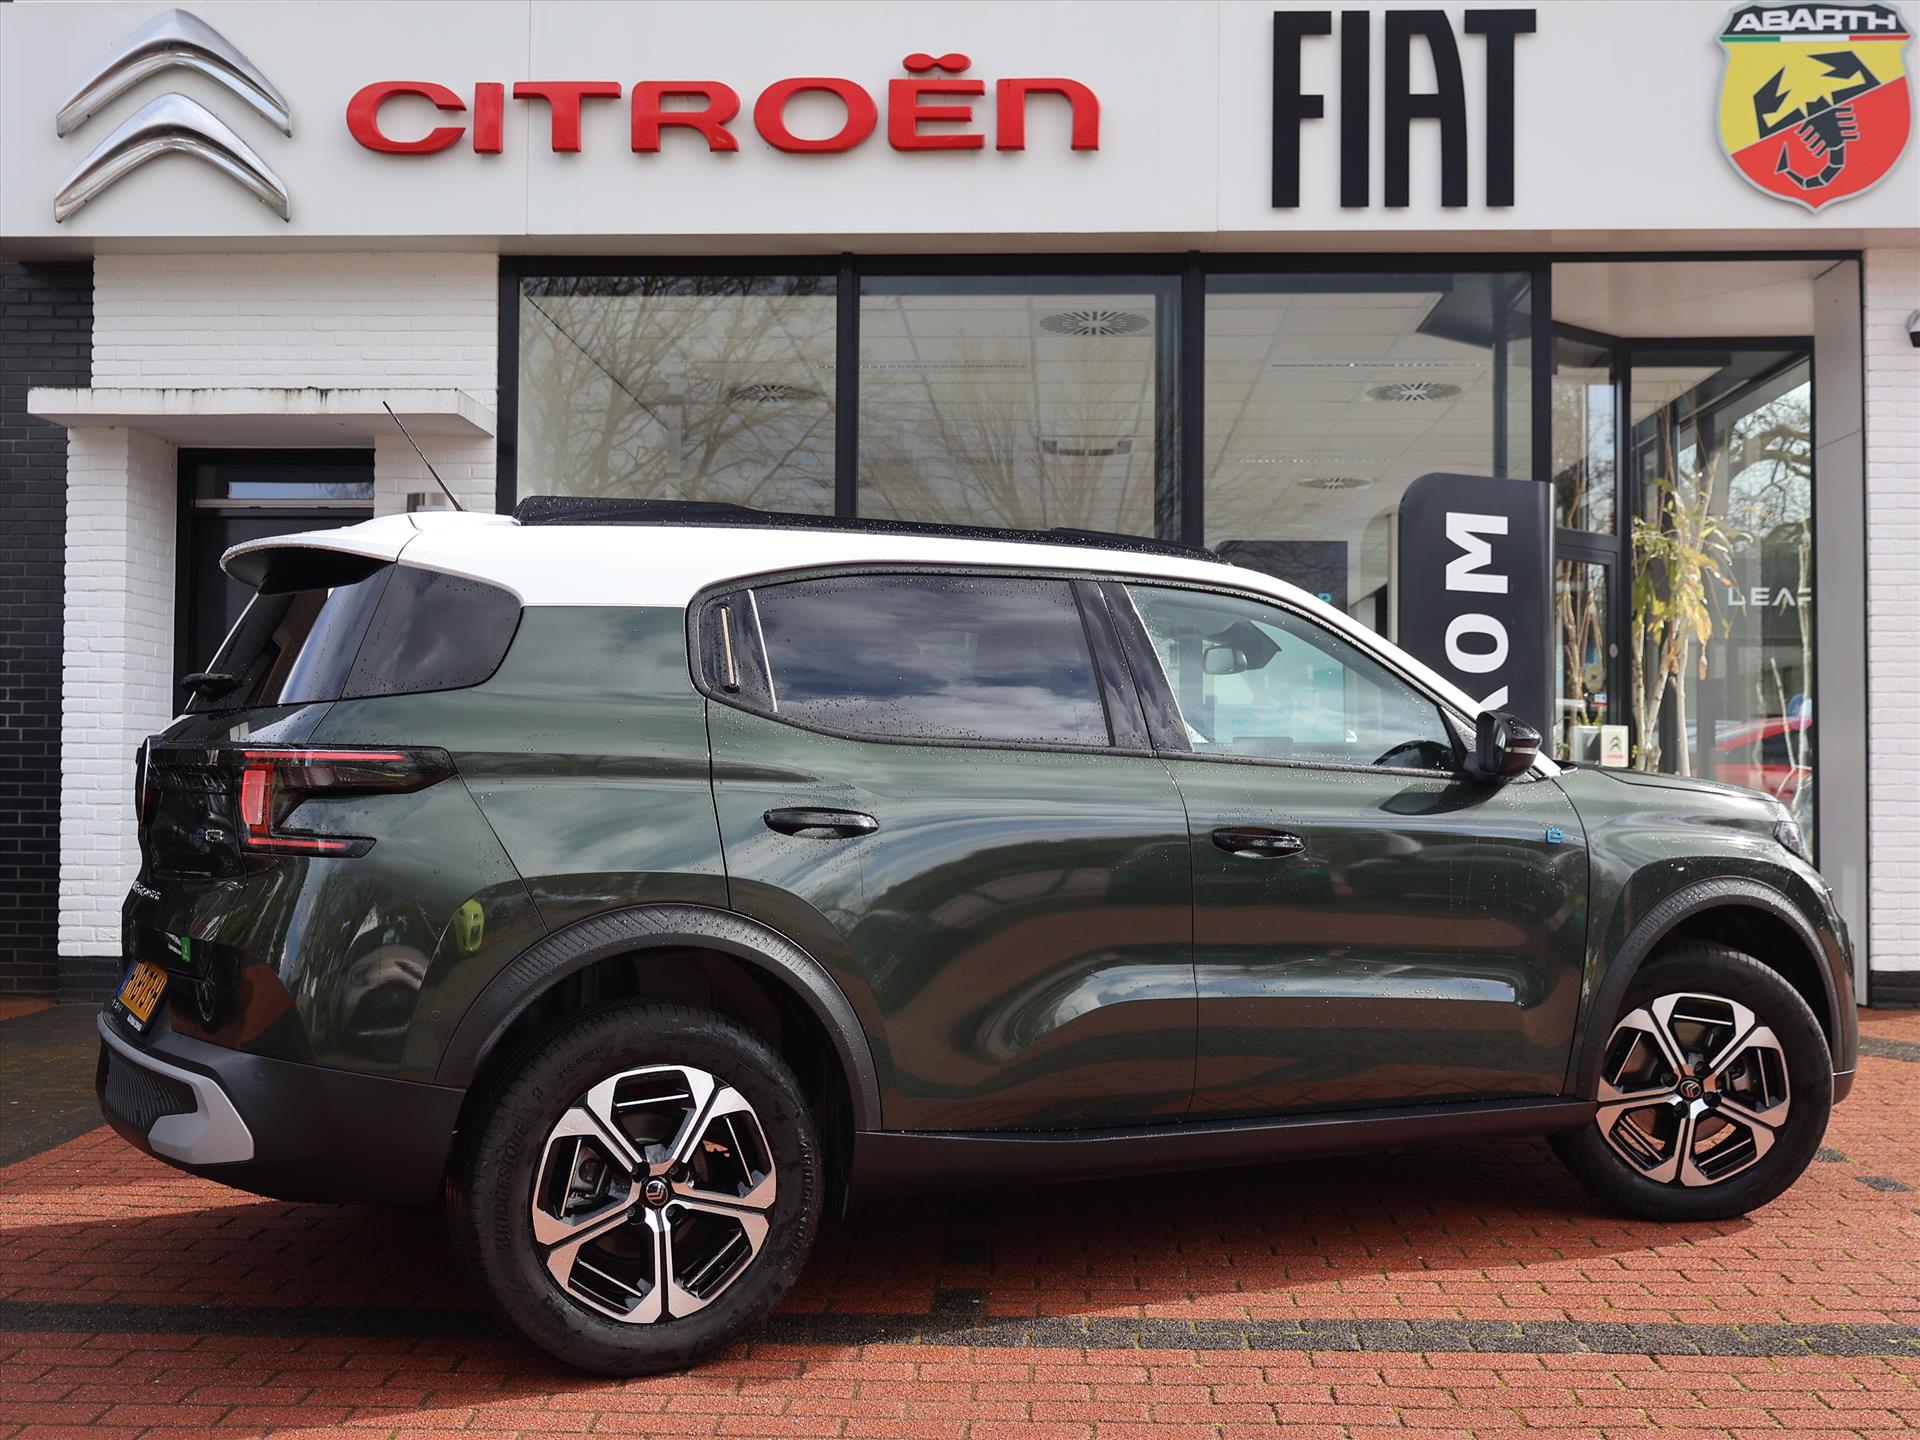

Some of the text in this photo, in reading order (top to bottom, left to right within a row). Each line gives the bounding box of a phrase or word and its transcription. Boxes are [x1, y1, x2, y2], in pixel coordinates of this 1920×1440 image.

[1732, 8, 1896, 32] ABARTH
[346, 53, 1100, 155] CITROËN
[1271, 9, 1537, 208] FIAT
